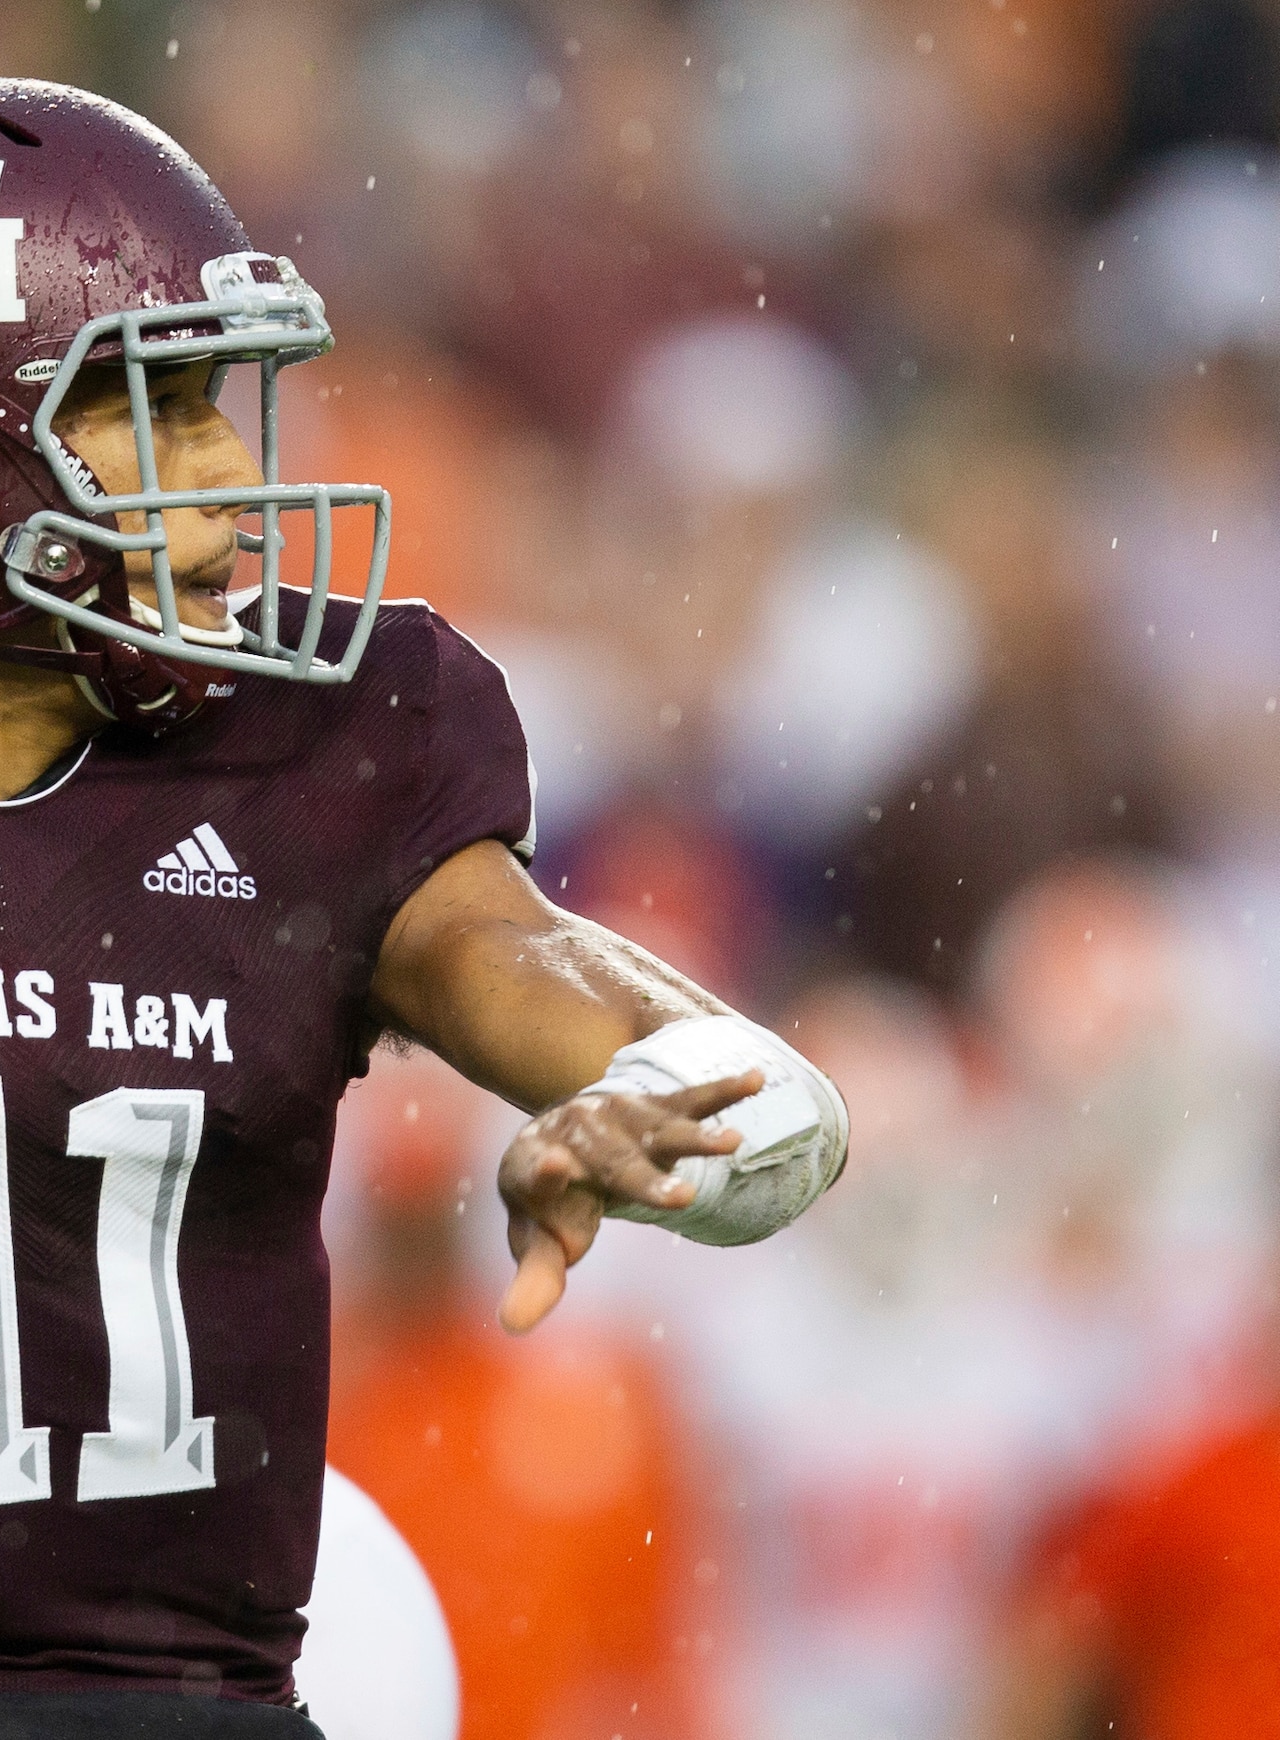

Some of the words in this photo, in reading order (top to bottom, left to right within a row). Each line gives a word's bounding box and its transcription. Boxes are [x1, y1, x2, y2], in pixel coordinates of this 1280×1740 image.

[20, 361, 62, 378] Riddel
[142, 866, 258, 900] adidas
[87, 981, 234, 1063] A&M
